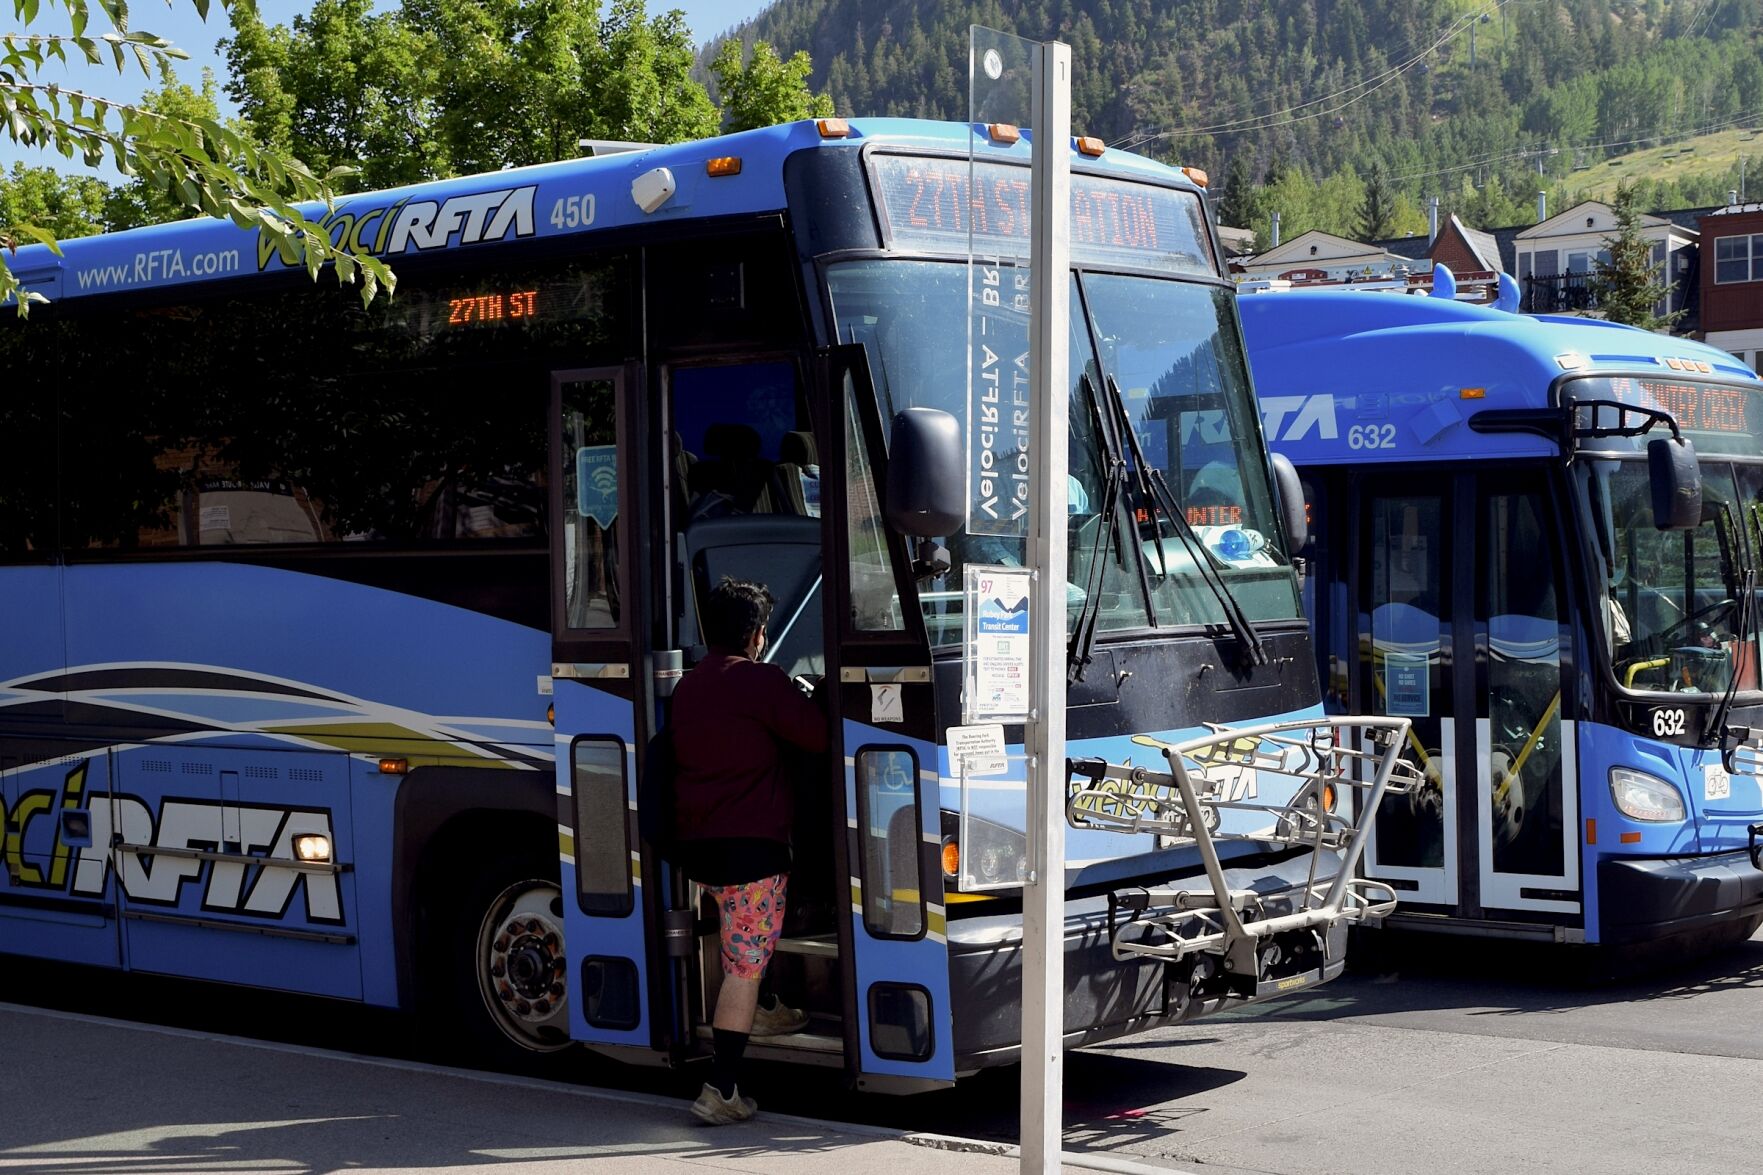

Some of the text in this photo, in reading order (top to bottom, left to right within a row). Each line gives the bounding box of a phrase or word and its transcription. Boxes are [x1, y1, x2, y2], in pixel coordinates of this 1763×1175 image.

[551, 194, 596, 229] 450
[907, 169, 988, 232] 27TH
[1074, 189, 1158, 249] ATION
[78, 248, 239, 289] www.RFTA.com
[449, 291, 537, 325] 27TH ST
[1640, 382, 1698, 429] HUNTER
[1702, 388, 1748, 432] CREEK
[1348, 423, 1396, 450] 632
[1186, 505, 1242, 526] UNTER
[981, 580, 993, 594] 97
[982, 622, 1019, 631] Transit Center
[1653, 709, 1686, 737] 632
